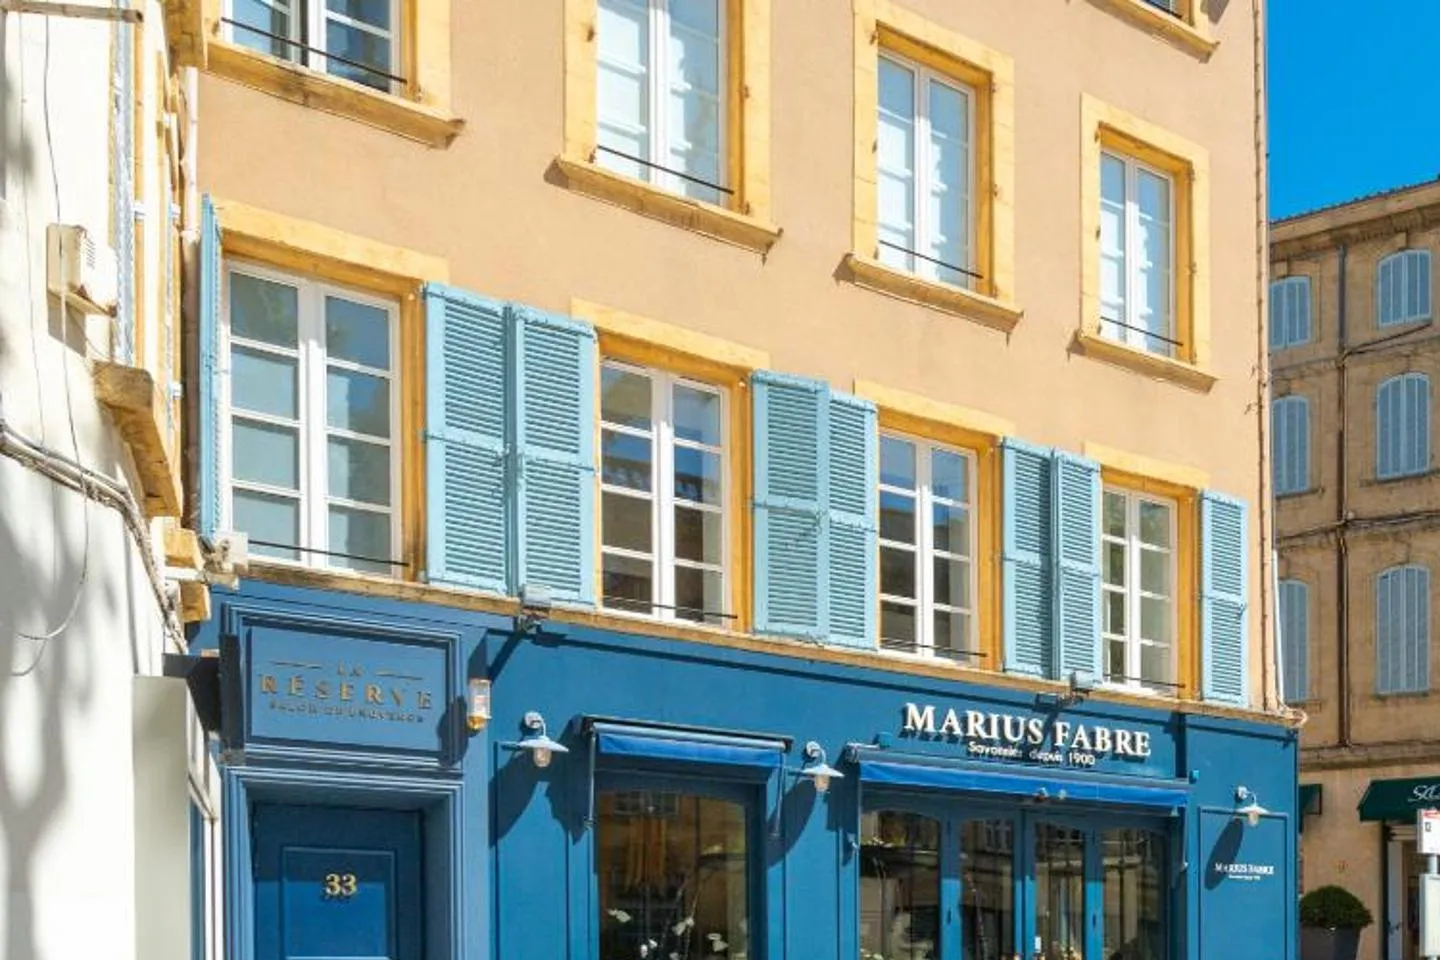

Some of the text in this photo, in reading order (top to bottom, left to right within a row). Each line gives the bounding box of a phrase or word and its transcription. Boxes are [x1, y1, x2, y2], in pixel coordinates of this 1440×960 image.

[259, 673, 432, 709] RÉSERVE
[903, 702, 1151, 757] MARIUS FABRE
[1068, 753, 1096, 766] 1900
[325, 873, 357, 896] 33
